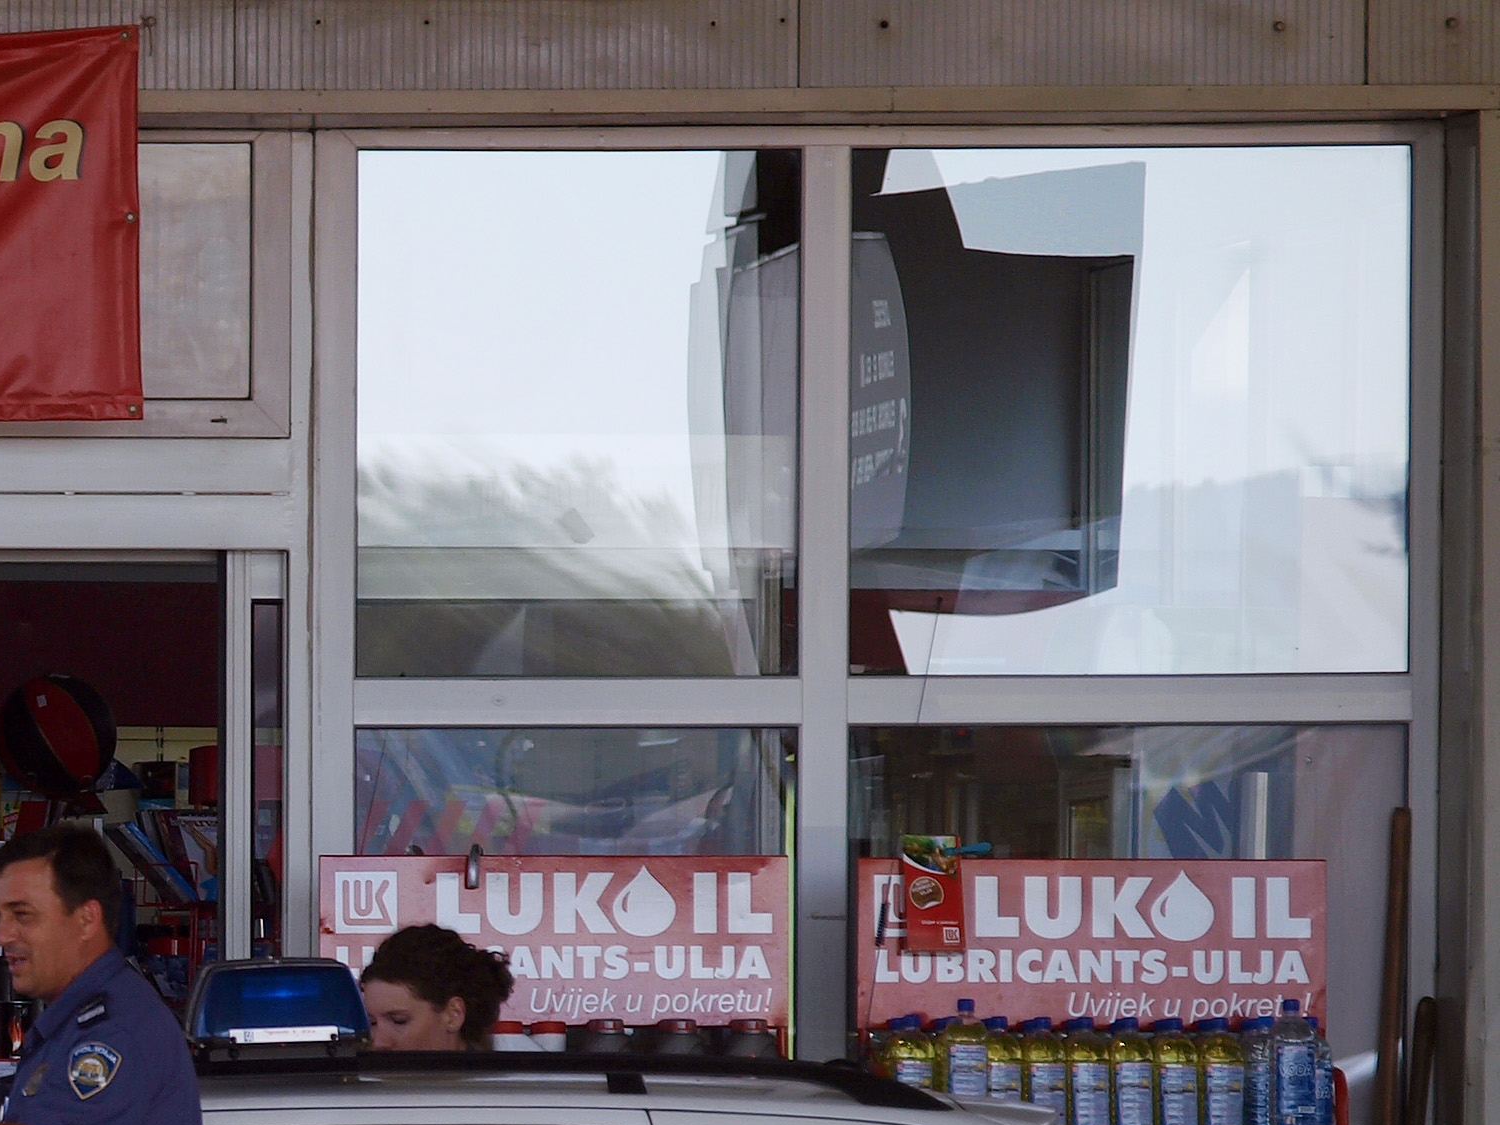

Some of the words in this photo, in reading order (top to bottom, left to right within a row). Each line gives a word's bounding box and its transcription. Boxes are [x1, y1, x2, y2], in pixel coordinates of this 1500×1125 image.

[336, 944, 772, 980] LANTS-ULJA
[874, 948, 1310, 985] LUBRICANTS-ULJA
[530, 986, 618, 1015] Uvijek
[625, 994, 643, 1014] u
[651, 986, 773, 1019] pokretu!
[1067, 991, 1154, 1019] Uvijek
[1164, 999, 1181, 1018] u
[1191, 991, 1312, 1022] pokret!
